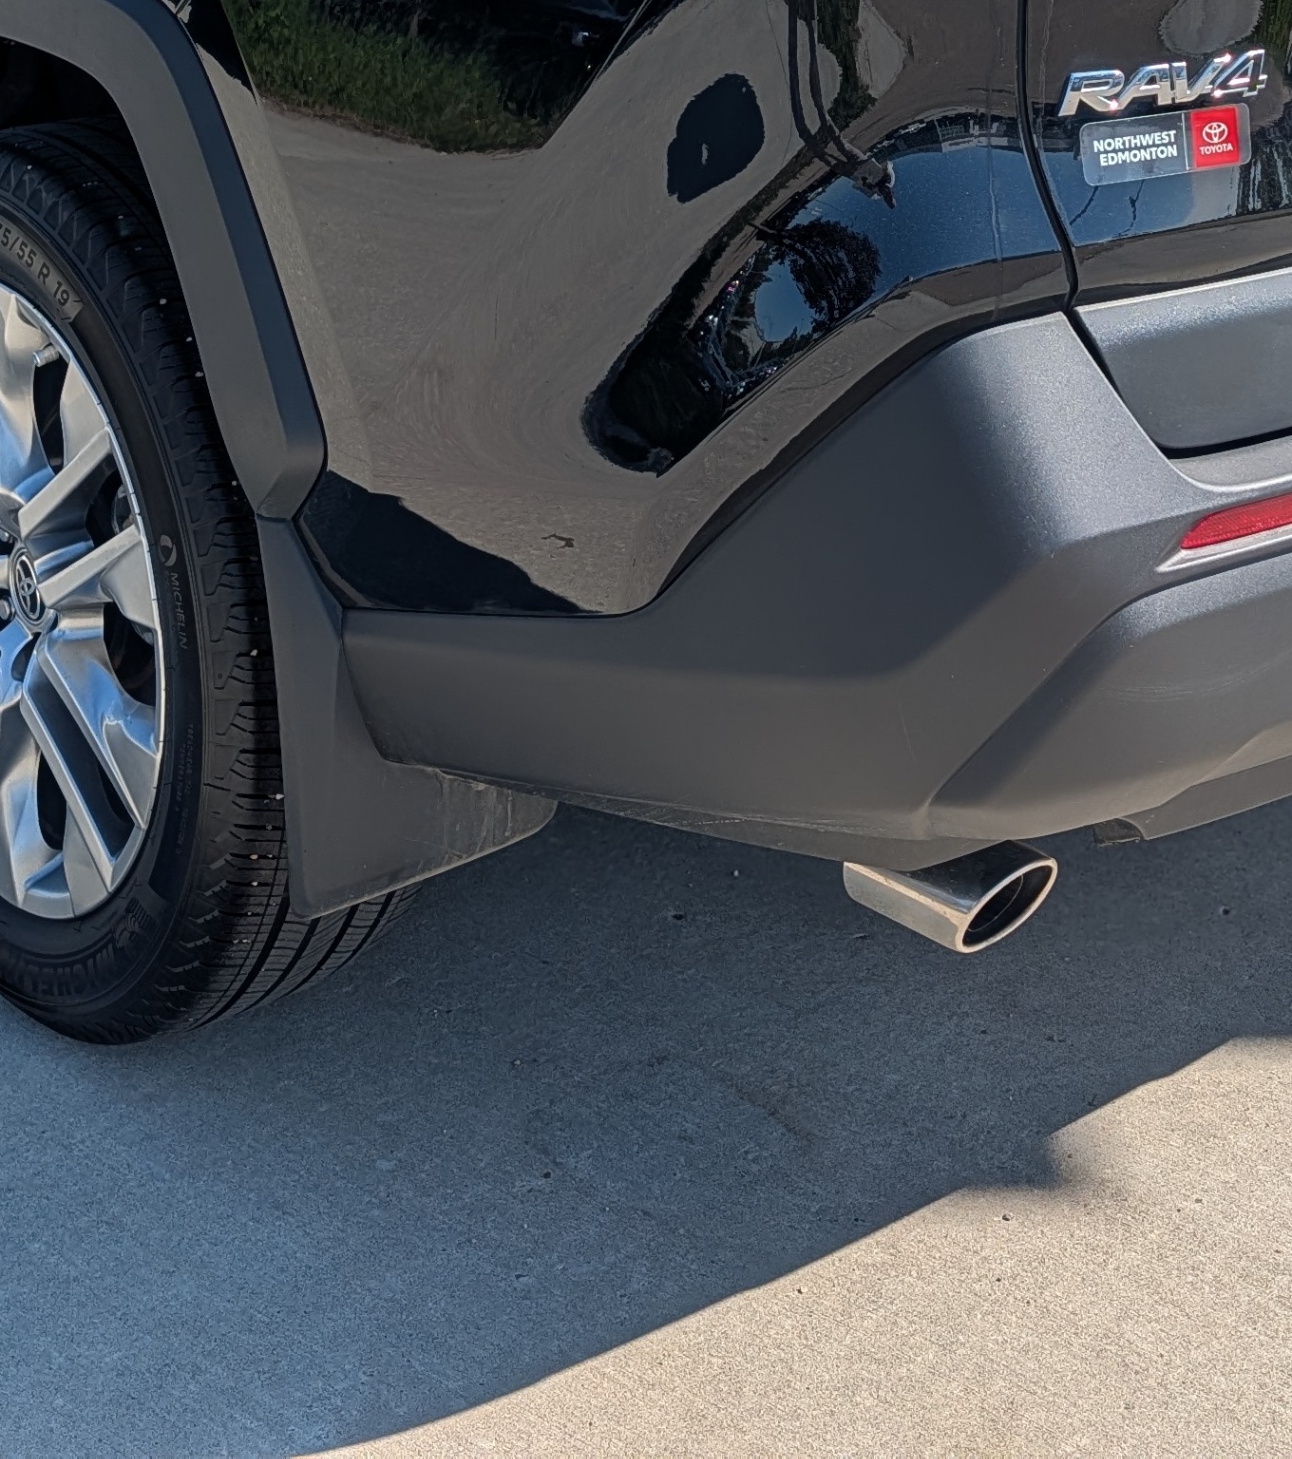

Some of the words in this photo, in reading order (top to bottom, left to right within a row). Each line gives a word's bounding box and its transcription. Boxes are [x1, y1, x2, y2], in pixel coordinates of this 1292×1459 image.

[1059, 49, 1267, 116] RAV4
[1093, 130, 1176, 152] NORTHWEST
[1099, 144, 1178, 167] EDMONTON
[1199, 142, 1233, 155] TOYOTA
[37, 261, 51, 285] R
[53, 282, 70, 307] 19
[170, 572, 188, 649] MICHELIN
